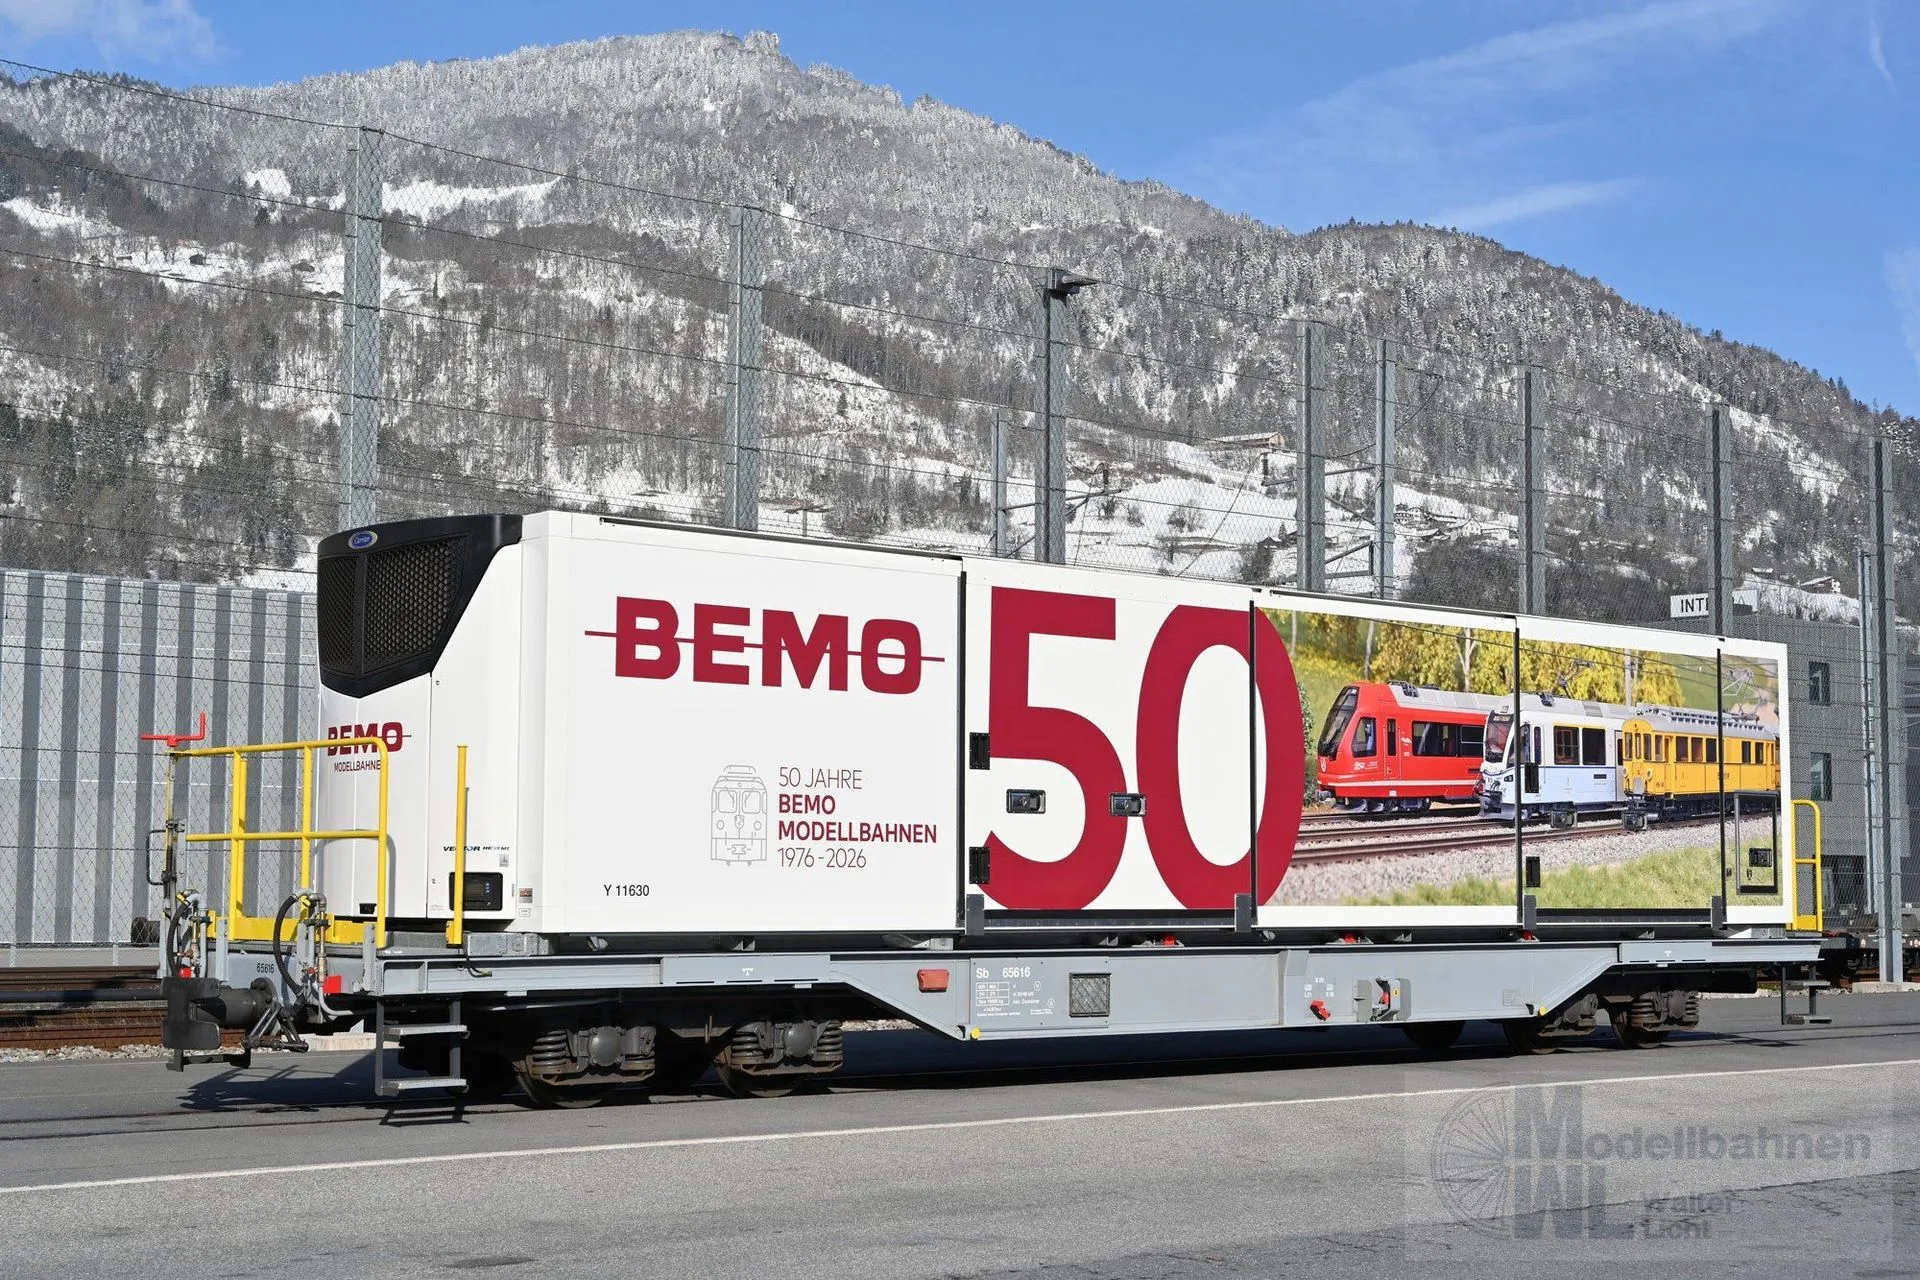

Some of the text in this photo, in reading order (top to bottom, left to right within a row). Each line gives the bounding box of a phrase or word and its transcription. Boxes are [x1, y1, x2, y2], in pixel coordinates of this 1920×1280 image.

[615, 596, 923, 695] BEMO
[327, 721, 403, 756] BEMO
[976, 586, 1306, 910] 50
[333, 759, 382, 773] MODELLBAHNE
[779, 767, 863, 790] 50 JAHRE
[778, 793, 836, 815] BEMO
[778, 820, 938, 844] MODELLBAHNEN
[603, 884, 650, 897] Y 11630
[975, 966, 1031, 979] Sb 65616
